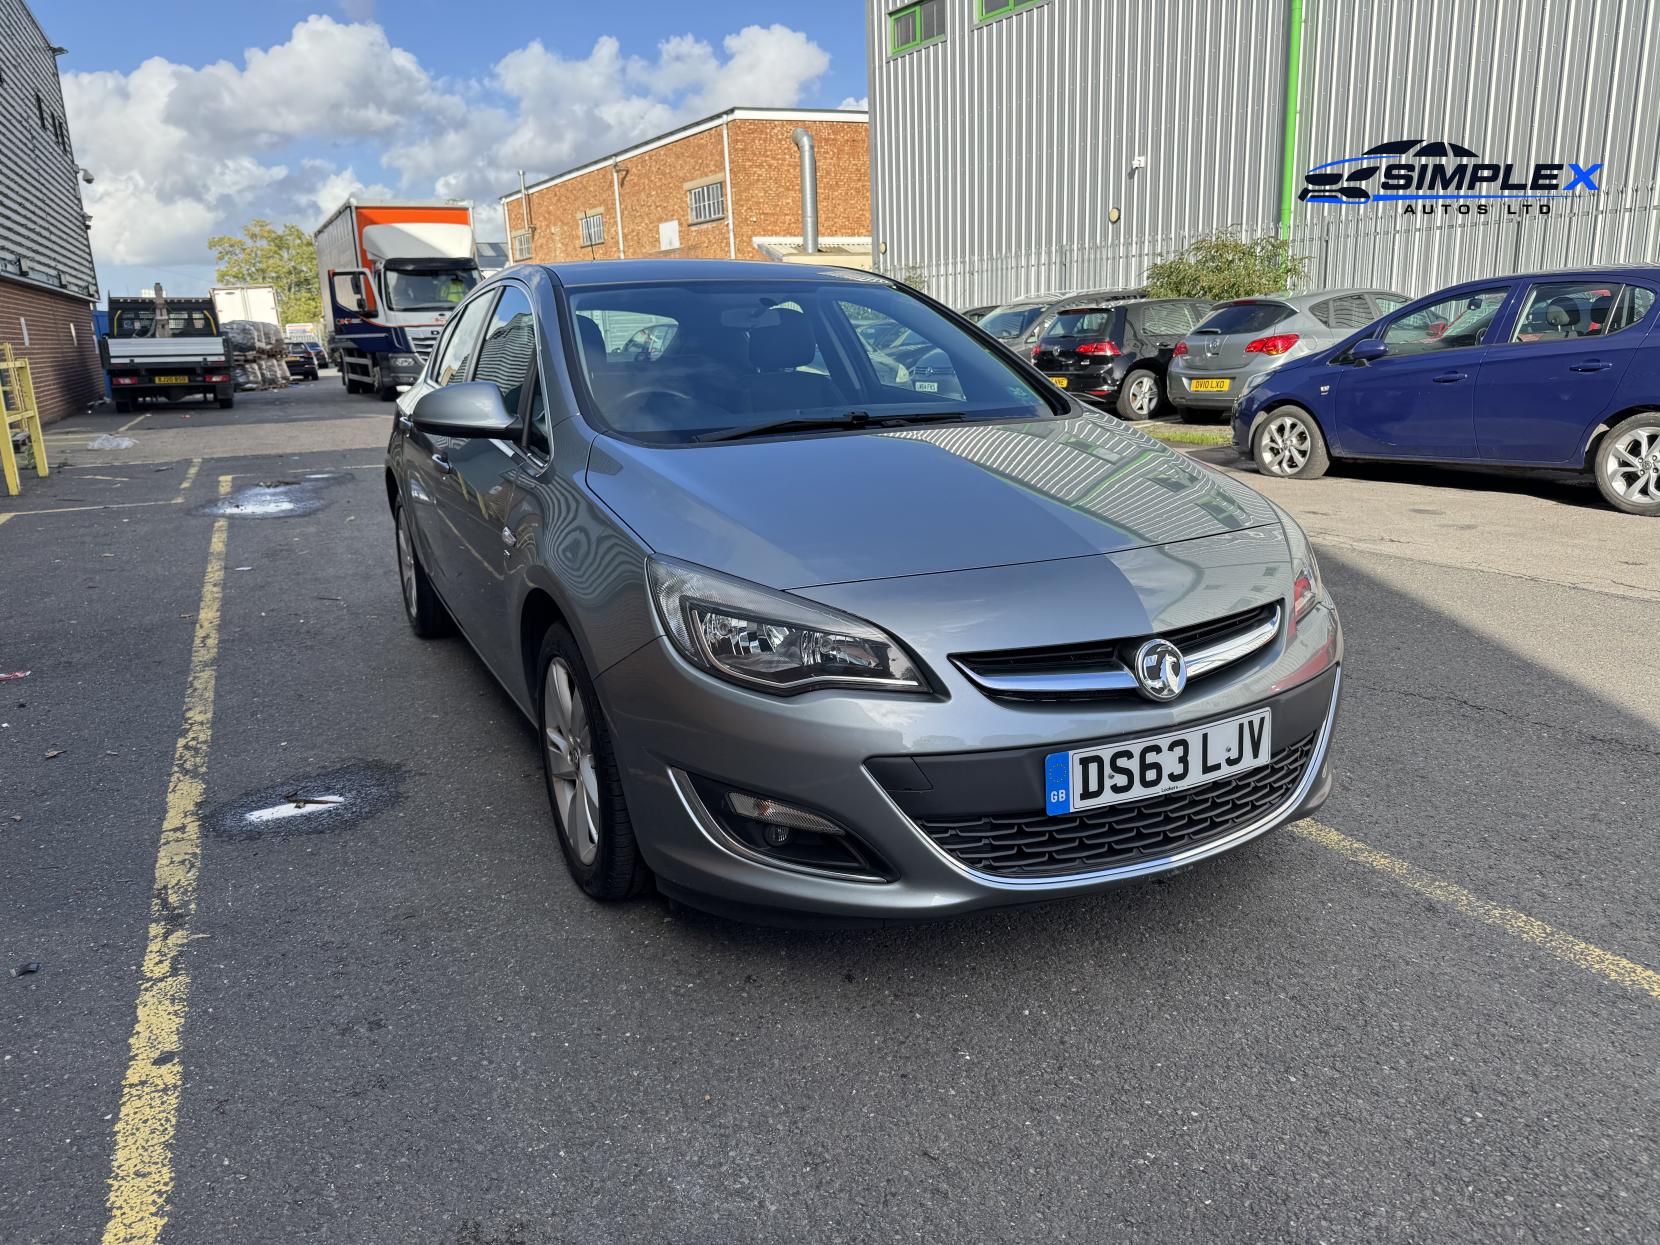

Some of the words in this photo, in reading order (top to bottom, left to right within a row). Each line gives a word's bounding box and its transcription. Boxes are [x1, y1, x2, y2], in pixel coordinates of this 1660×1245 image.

[1079, 738, 1190, 802] DS63
[1201, 716, 1266, 776] LJV
[1050, 789, 1066, 802] GB
